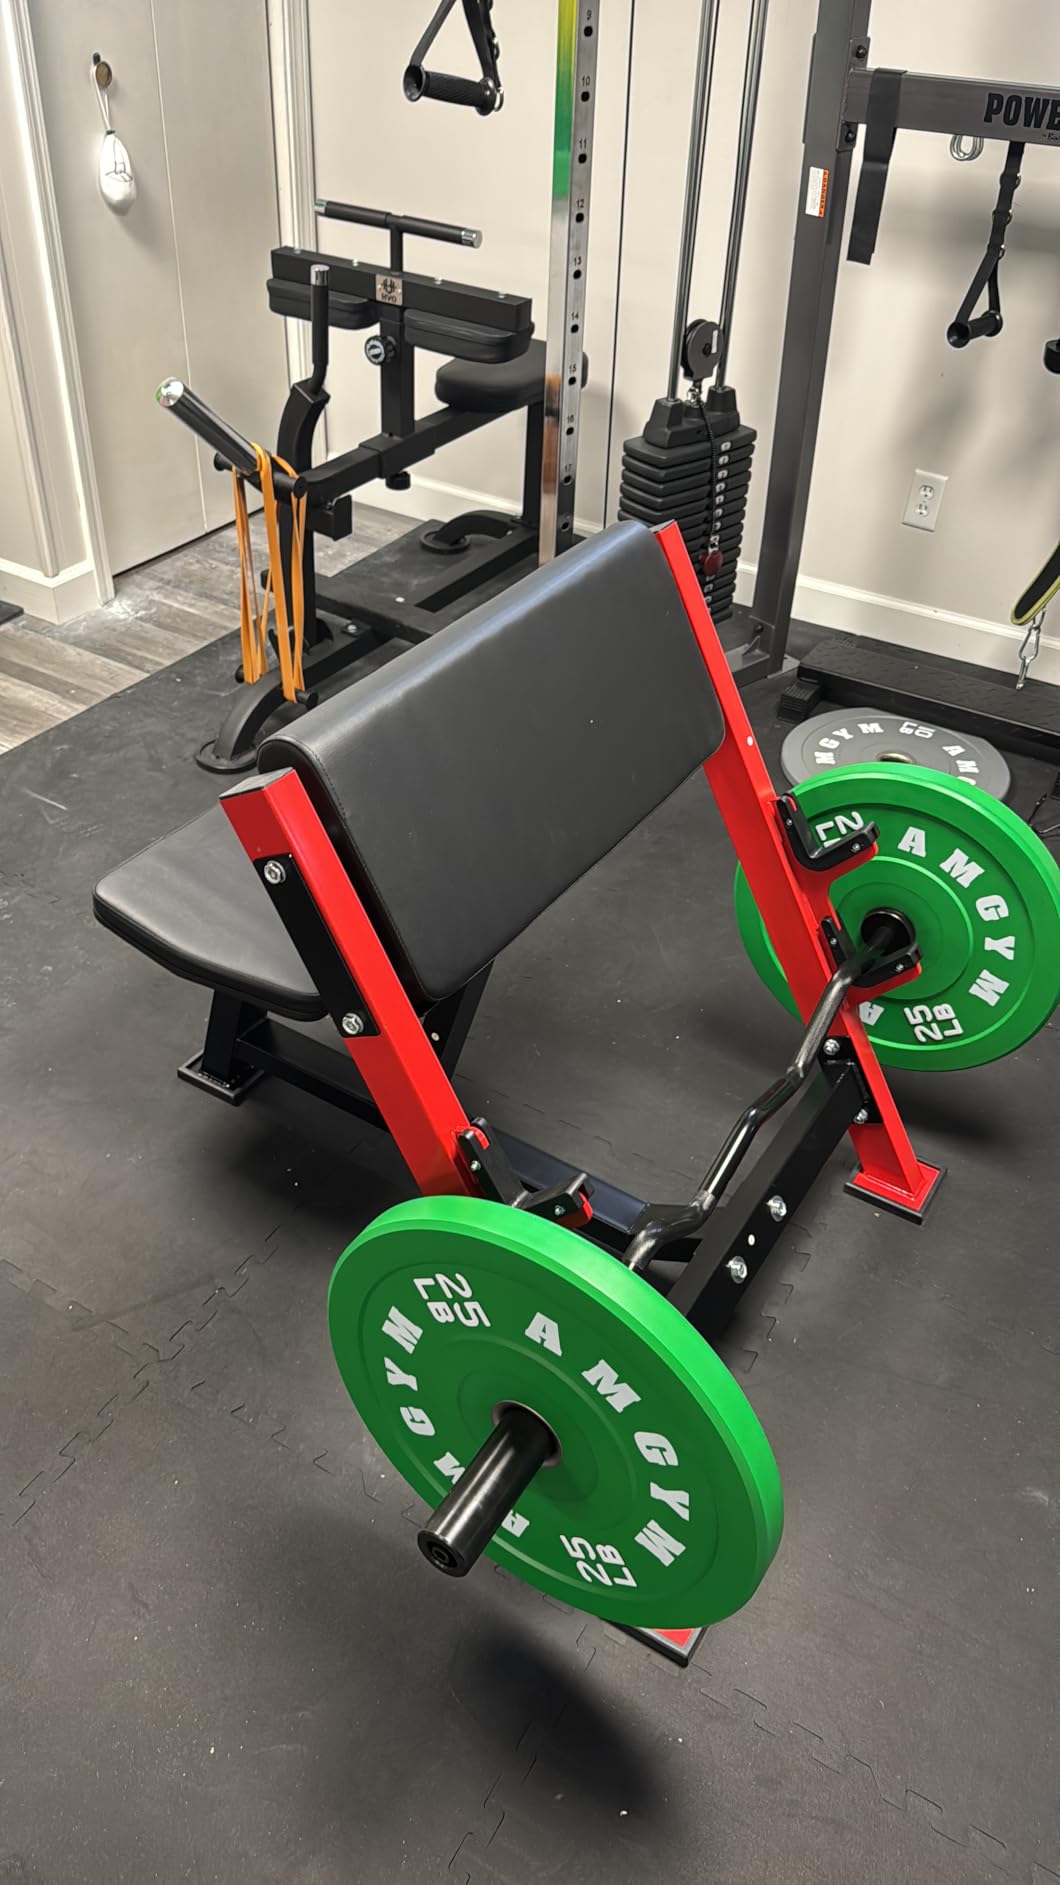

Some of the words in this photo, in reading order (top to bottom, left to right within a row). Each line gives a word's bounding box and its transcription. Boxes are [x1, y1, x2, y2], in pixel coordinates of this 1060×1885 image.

[586, 9, 592, 20] 9
[581, 75, 591, 87] 10
[578, 139, 588, 149] 11
[575, 199, 585, 209] 12
[573, 256, 582, 266] 13
[571, 312, 579, 321] 14
[564, 463, 572, 473] 17
[814, 722, 884, 765] MGYM
[897, 826, 1016, 1007] AMGYM
[903, 1004, 943, 1042] 25
[932, 1003, 964, 1037] LB
[413, 1278, 455, 1323] LB
[435, 1273, 491, 1328] 25
[524, 1312, 690, 1567] AMGYM
[559, 1534, 613, 1587] 25
[595, 1544, 637, 1588] LB
